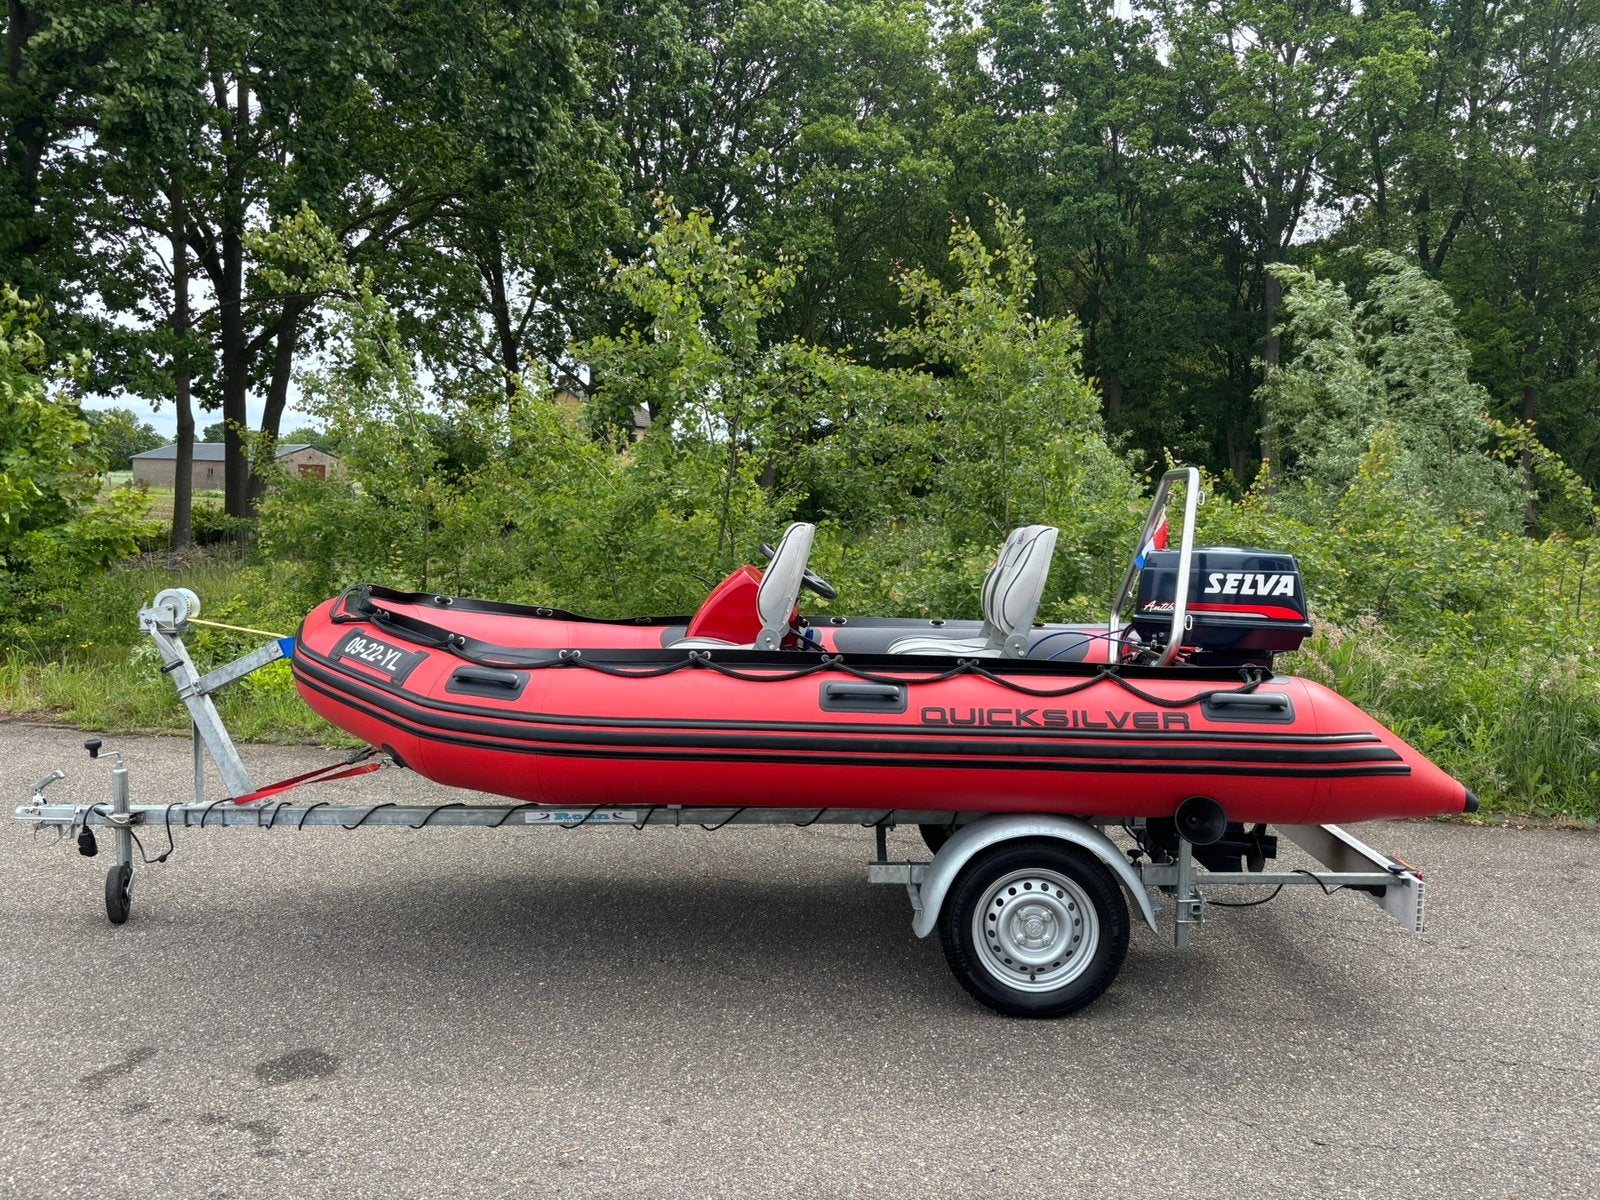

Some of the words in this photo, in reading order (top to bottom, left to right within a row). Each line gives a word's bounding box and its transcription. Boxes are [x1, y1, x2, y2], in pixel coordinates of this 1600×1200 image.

[1204, 573, 1294, 597] SELVA
[1143, 600, 1176, 612] Antib
[345, 637, 402, 671] 09-22-YL
[920, 706, 1190, 729] QUICKSILVER
